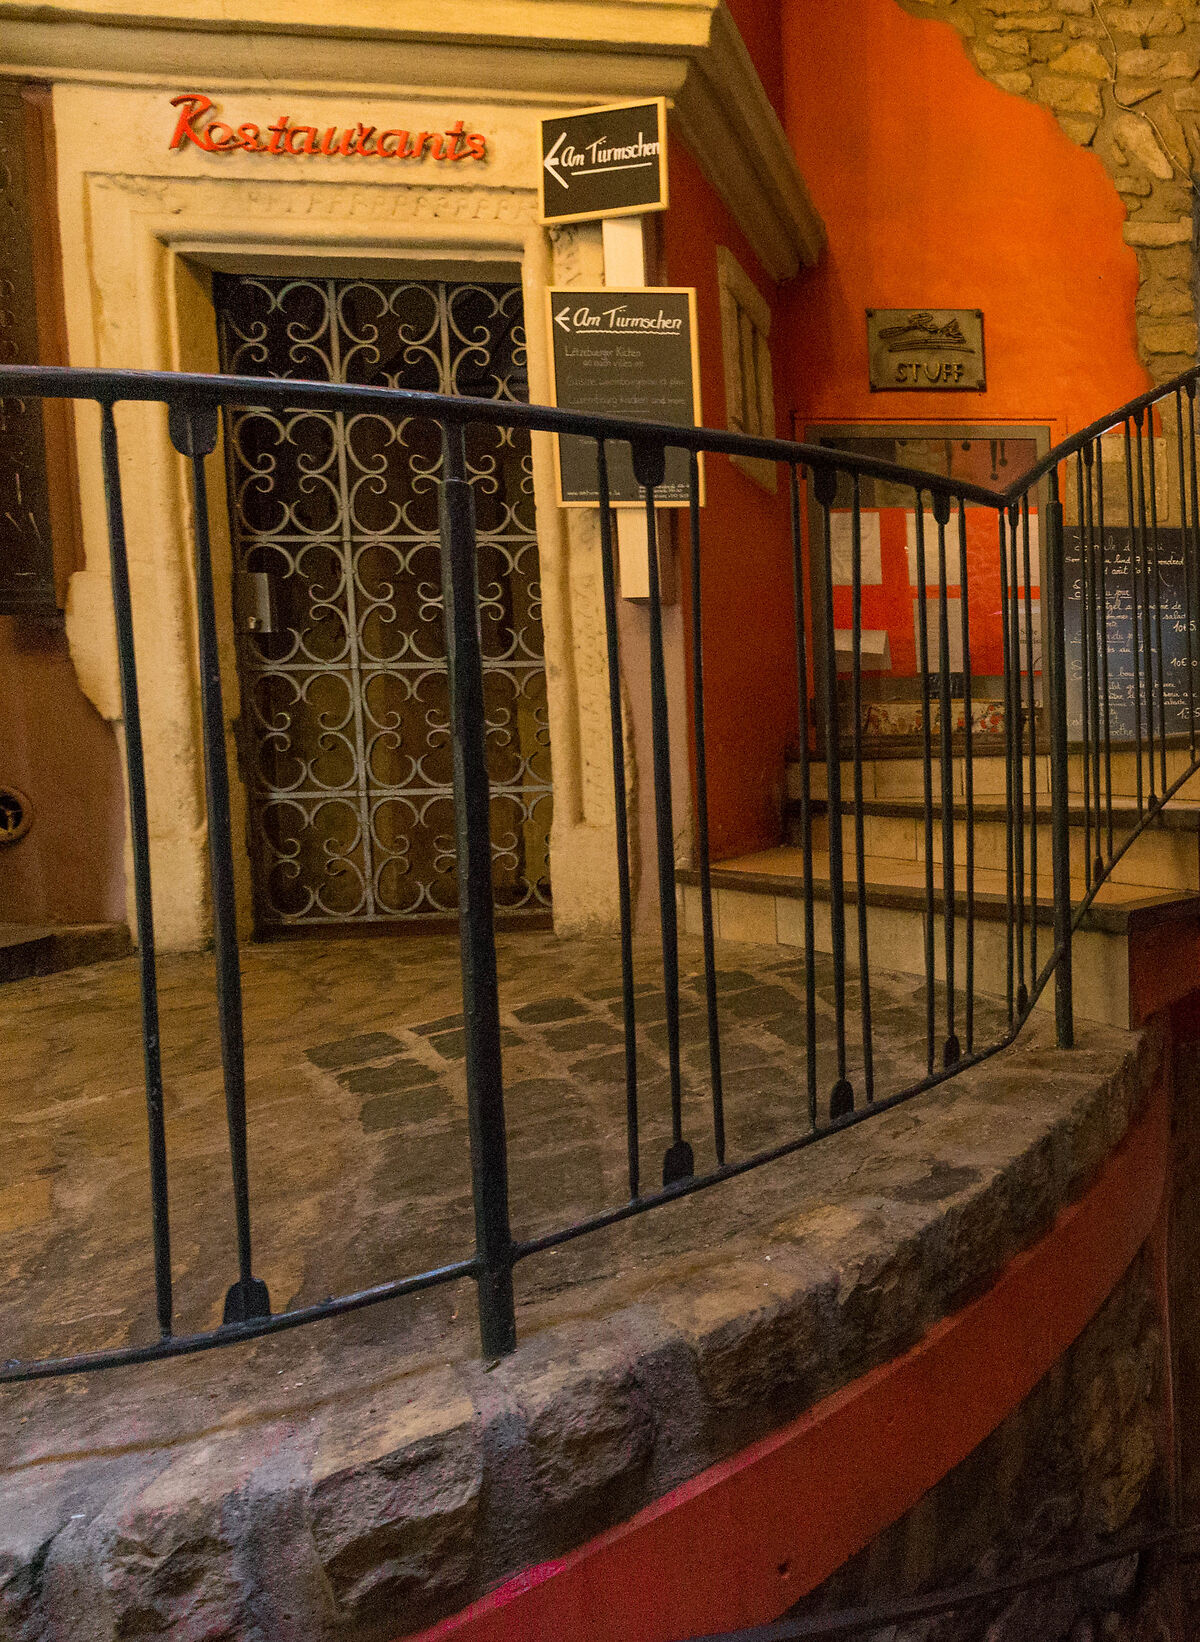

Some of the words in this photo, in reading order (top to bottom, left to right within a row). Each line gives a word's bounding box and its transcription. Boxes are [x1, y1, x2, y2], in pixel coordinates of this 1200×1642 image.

[168, 94, 487, 161] Restaurants
[561, 145, 585, 167] Am
[573, 307, 601, 327] Am
[895, 362, 963, 383] STUFF
